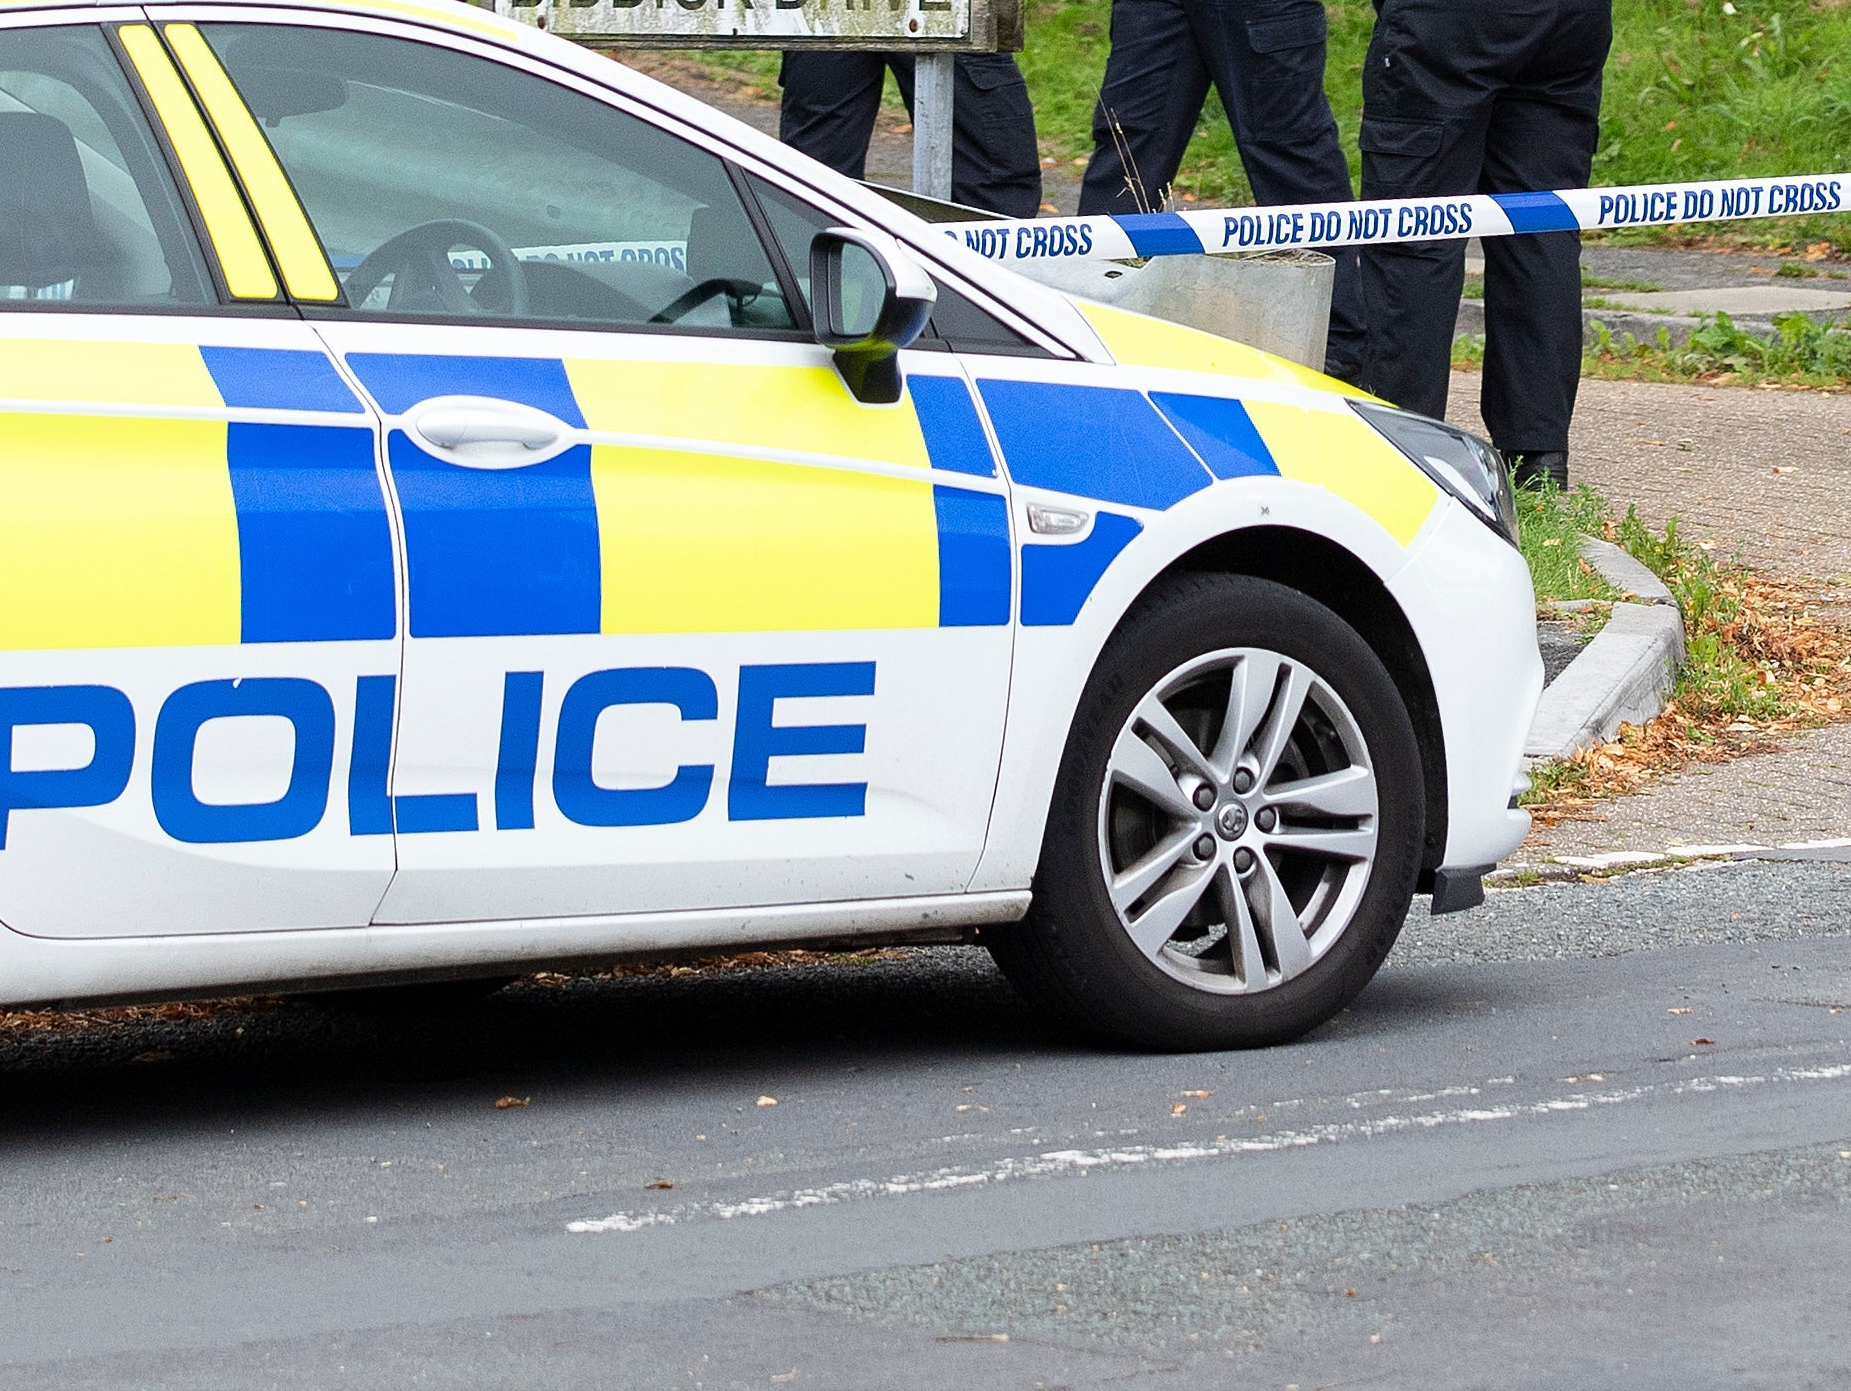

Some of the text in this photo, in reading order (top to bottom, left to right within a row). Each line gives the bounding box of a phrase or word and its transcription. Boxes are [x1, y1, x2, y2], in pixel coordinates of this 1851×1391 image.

[1221, 202, 1473, 248] POLICE DO NOT CROSS
[1597, 181, 1842, 225] POLICE DO NOT CROSS
[966, 222, 1093, 260] NOT CROSS
